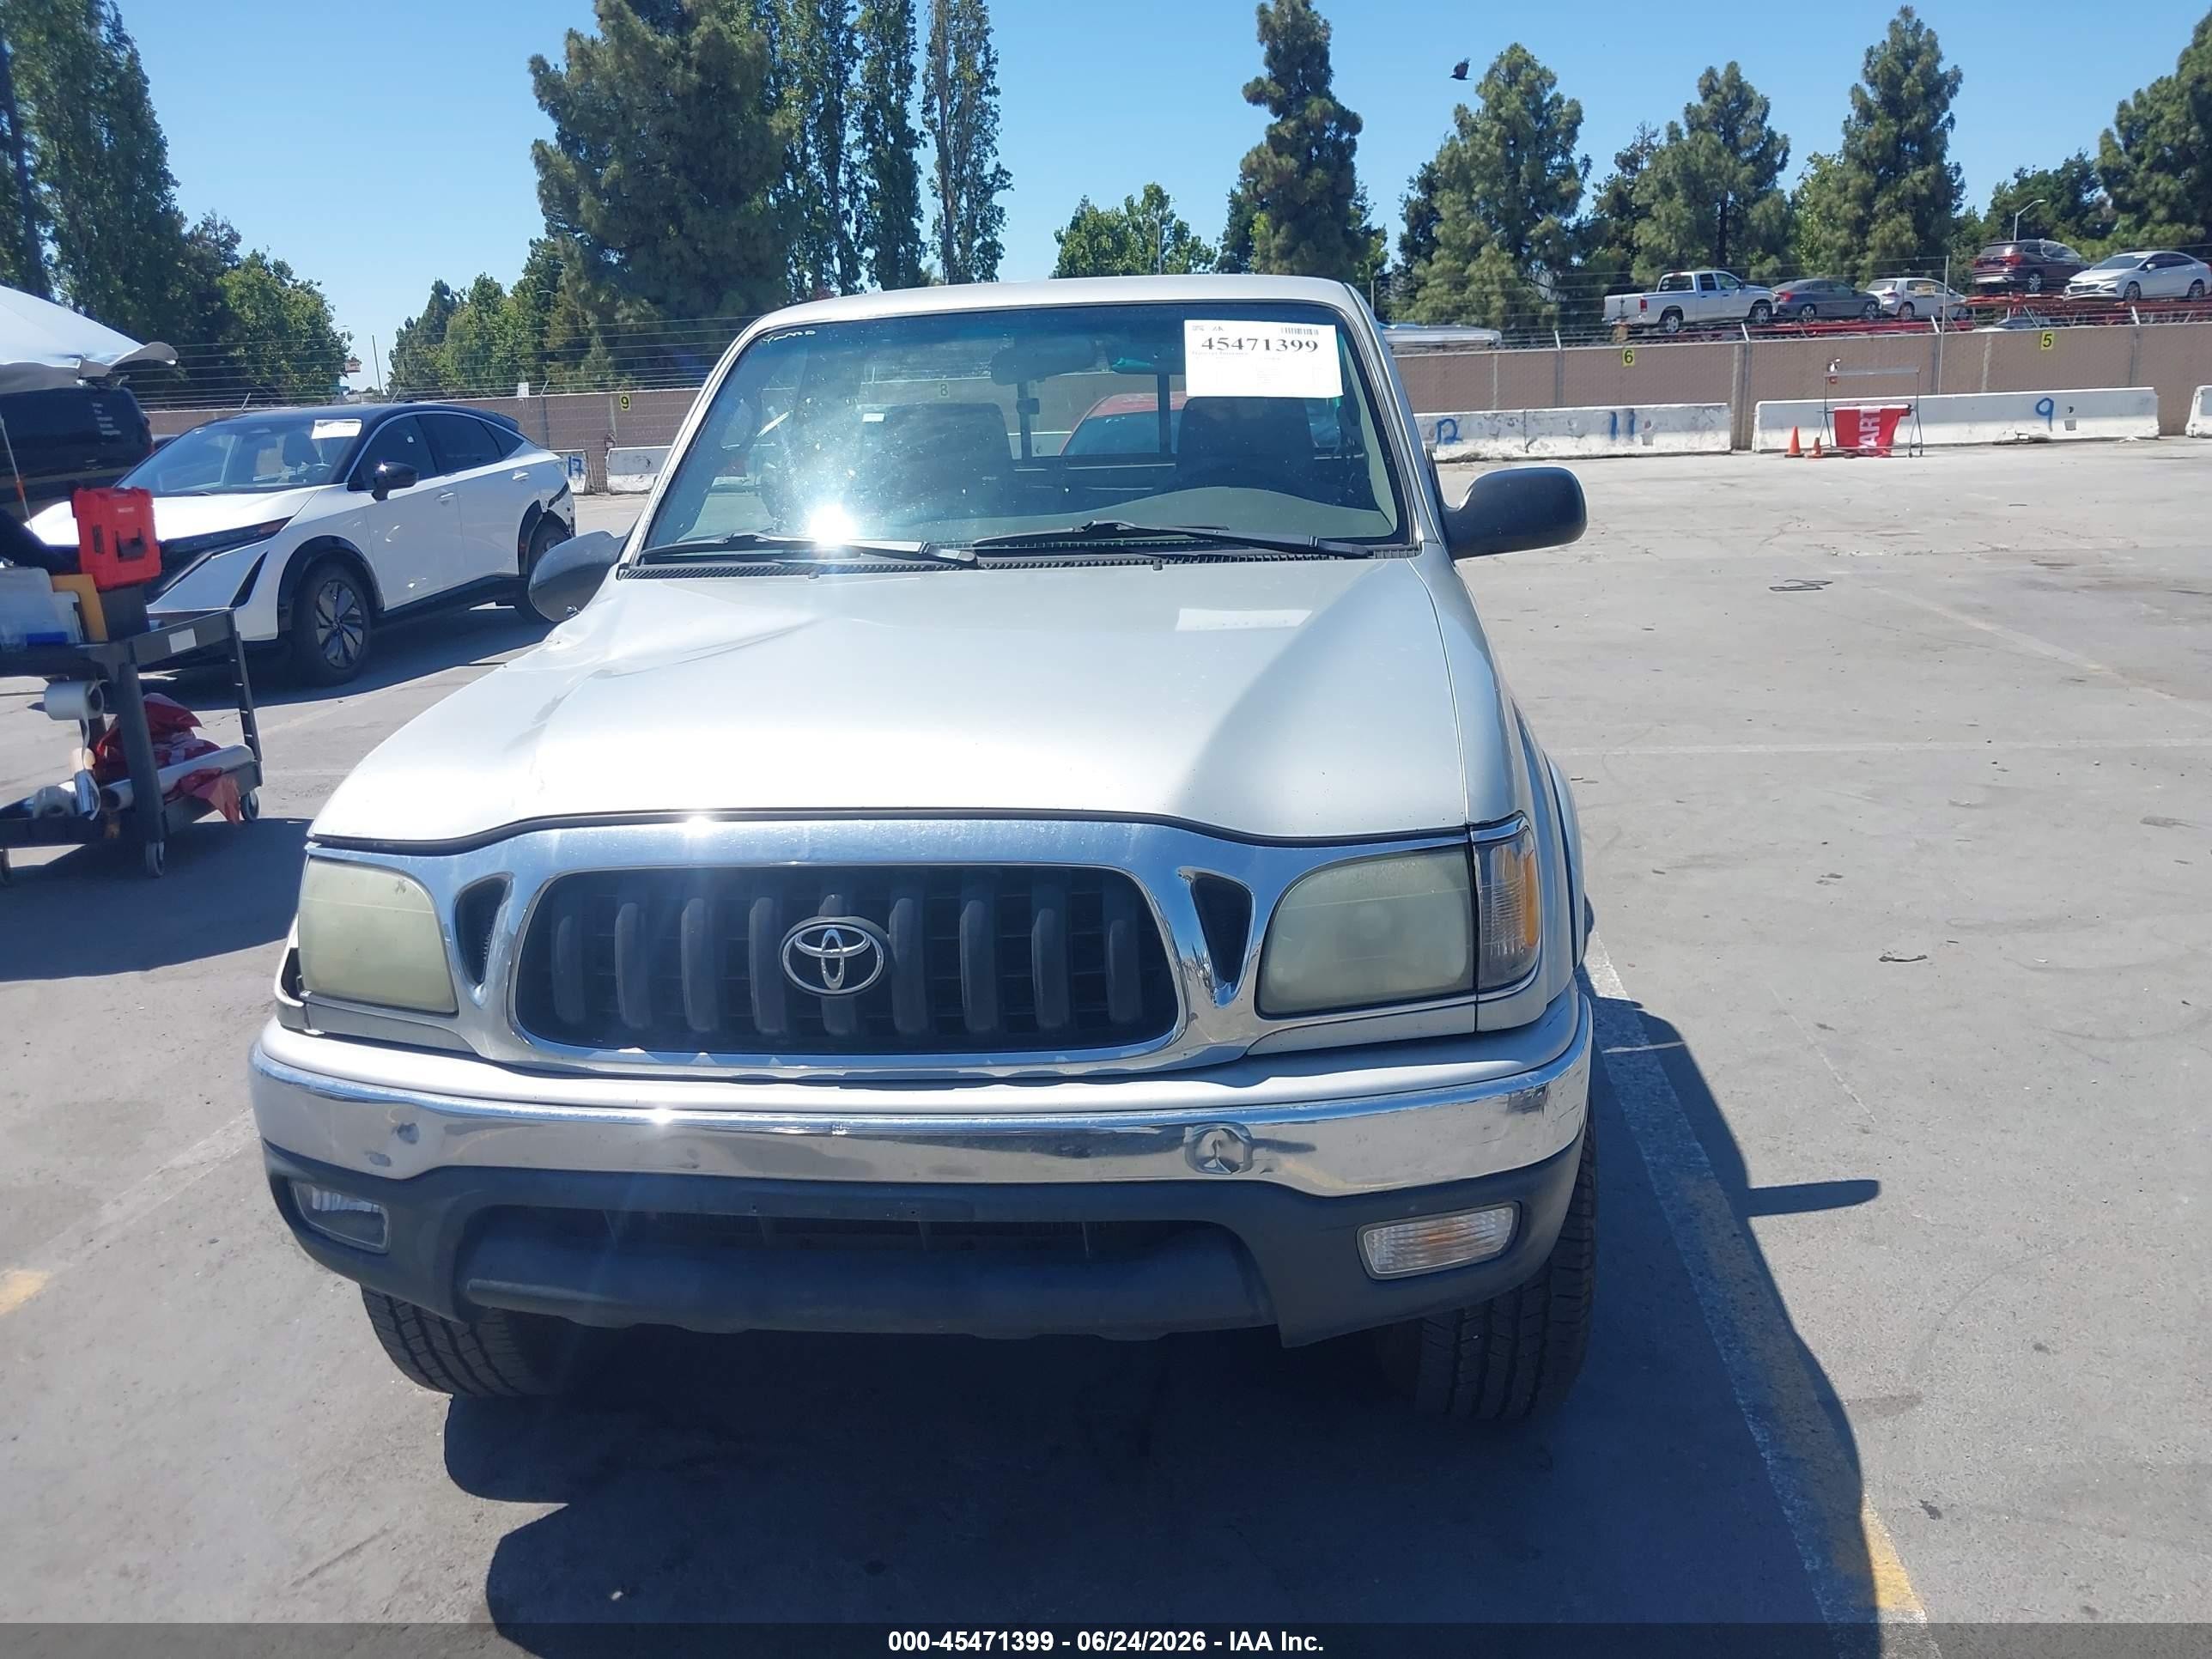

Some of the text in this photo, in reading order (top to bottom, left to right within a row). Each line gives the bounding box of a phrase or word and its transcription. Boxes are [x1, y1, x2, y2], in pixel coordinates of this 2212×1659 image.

[1201, 337, 1318, 353] 45471399
[2042, 333, 2052, 348] 5
[1624, 349, 1633, 364] 6
[621, 396, 629, 410] 9
[2035, 397, 2055, 432] 9
